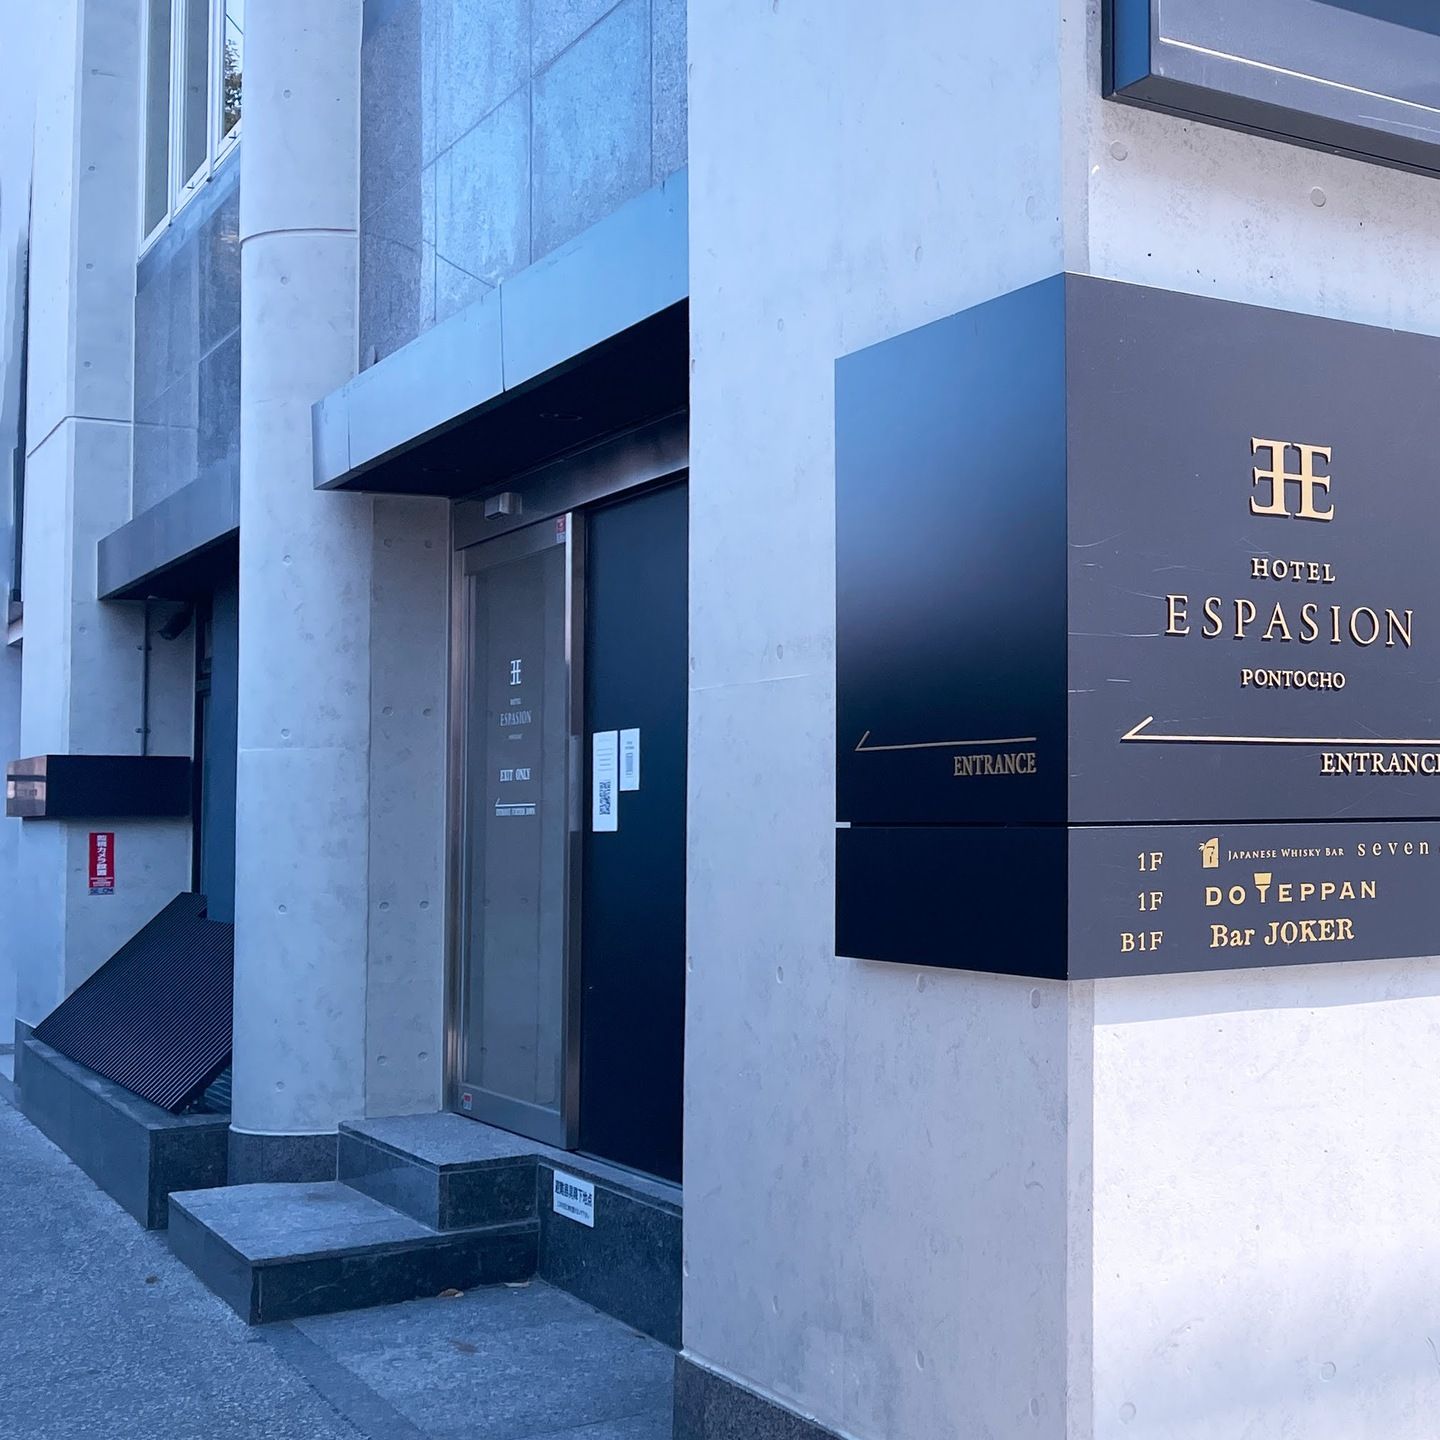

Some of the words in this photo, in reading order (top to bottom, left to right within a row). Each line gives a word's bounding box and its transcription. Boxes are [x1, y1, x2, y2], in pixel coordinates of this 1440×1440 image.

[1251, 557, 1336, 582] HOTEL
[1166, 594, 1413, 647] ESPASION
[1241, 668, 1346, 689] PONTOCHO
[500, 710, 532, 727] ESPASION
[500, 769, 513, 781] EXIT
[516, 768, 531, 780] ONLY
[953, 753, 1037, 776] ENTRANCE
[1138, 852, 1163, 871] 1F
[1228, 849, 1277, 861] JAPANESE
[1281, 848, 1321, 857] WHISKY
[1325, 847, 1344, 856] BAR
[1357, 841, 1429, 857] seven
[1205, 873, 1376, 906] DOTEPPAN
[1138, 892, 1163, 912] 1F
[1120, 931, 1163, 952] B1F
[1209, 923, 1256, 948] Bar
[1264, 917, 1355, 945] JOKER
